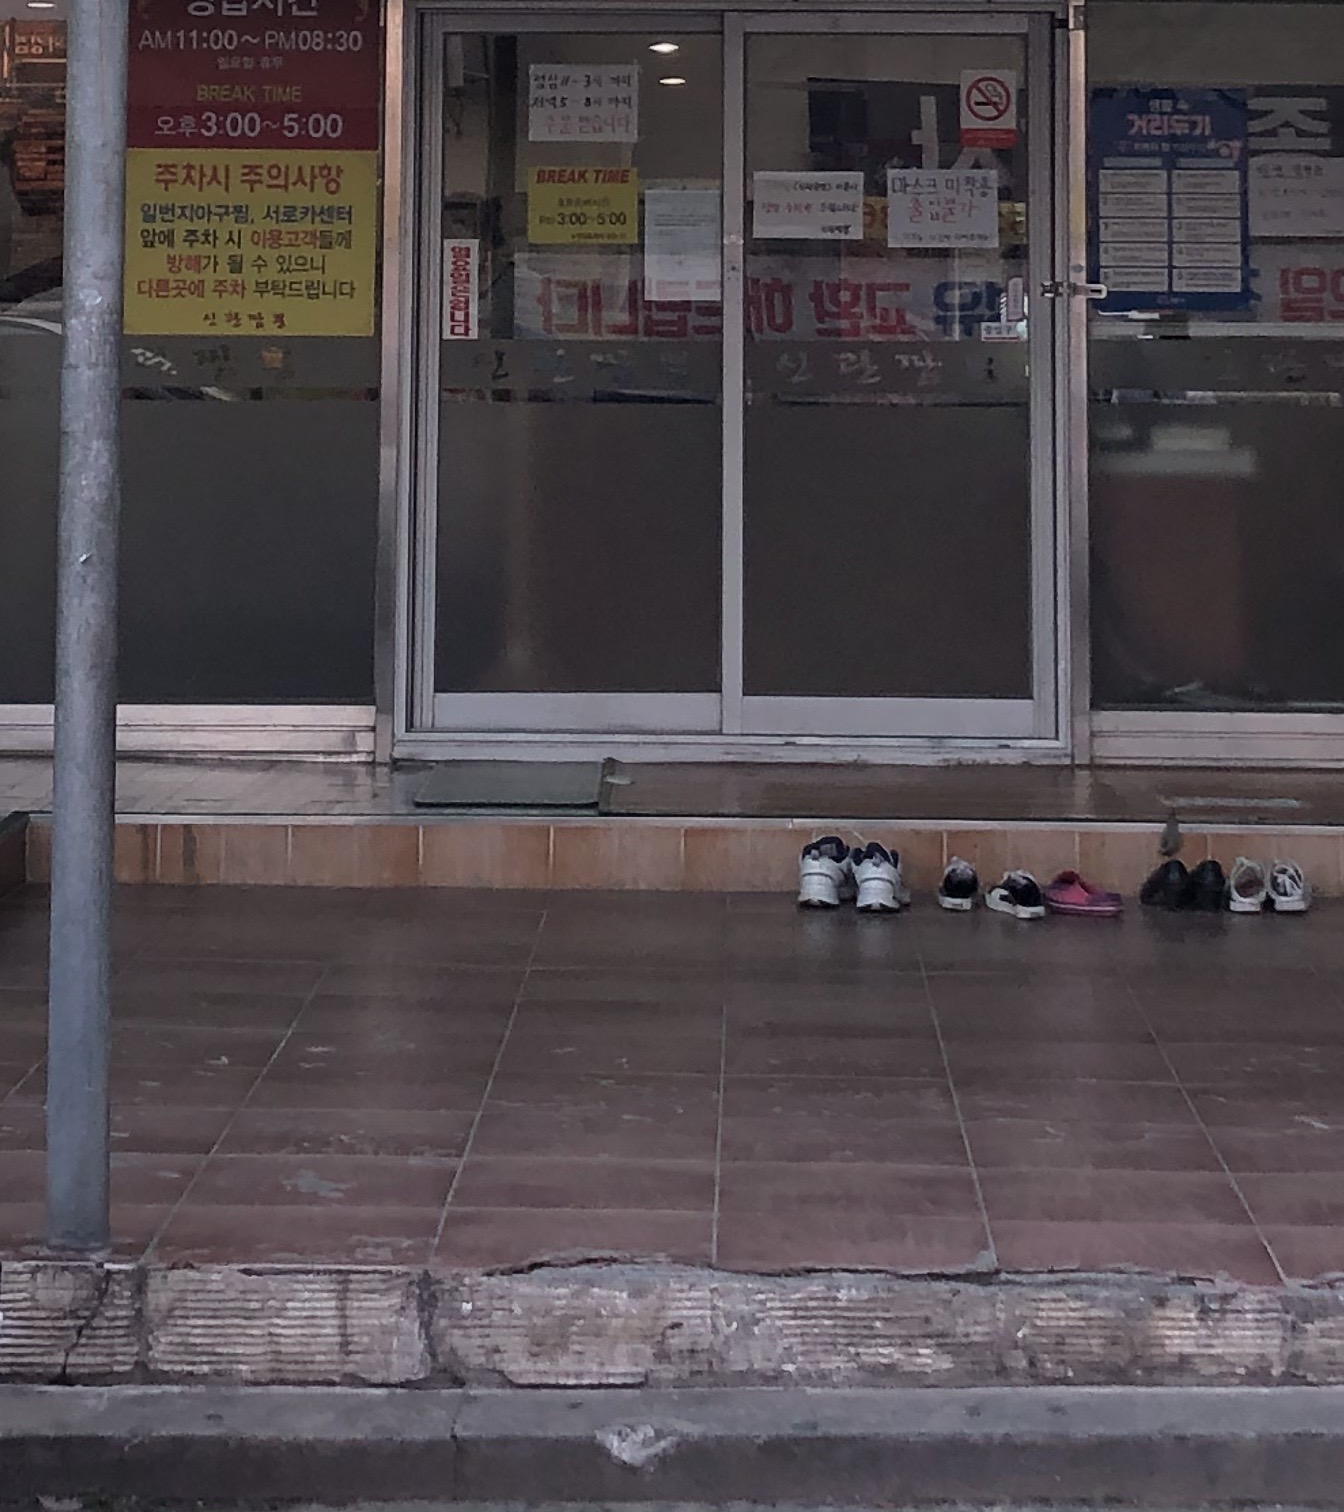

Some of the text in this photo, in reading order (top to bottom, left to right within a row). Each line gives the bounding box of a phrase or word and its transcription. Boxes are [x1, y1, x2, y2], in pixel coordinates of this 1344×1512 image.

[196, 85, 302, 102] BREAK TIME
[155, 163, 344, 195] 주차시 주의사항
[536, 169, 631, 184] BREAK TIME
[892, 176, 940, 195] 마스크
[263, 204, 353, 225] 서로카센터
[140, 230, 353, 249] 앞에 주차 시 이용고객들께
[166, 254, 219, 274] 방해가
[251, 255, 268, 273] 수
[276, 254, 326, 274] 있으니
[137, 279, 356, 300] 다른곳에 주차 부탁드립니다
